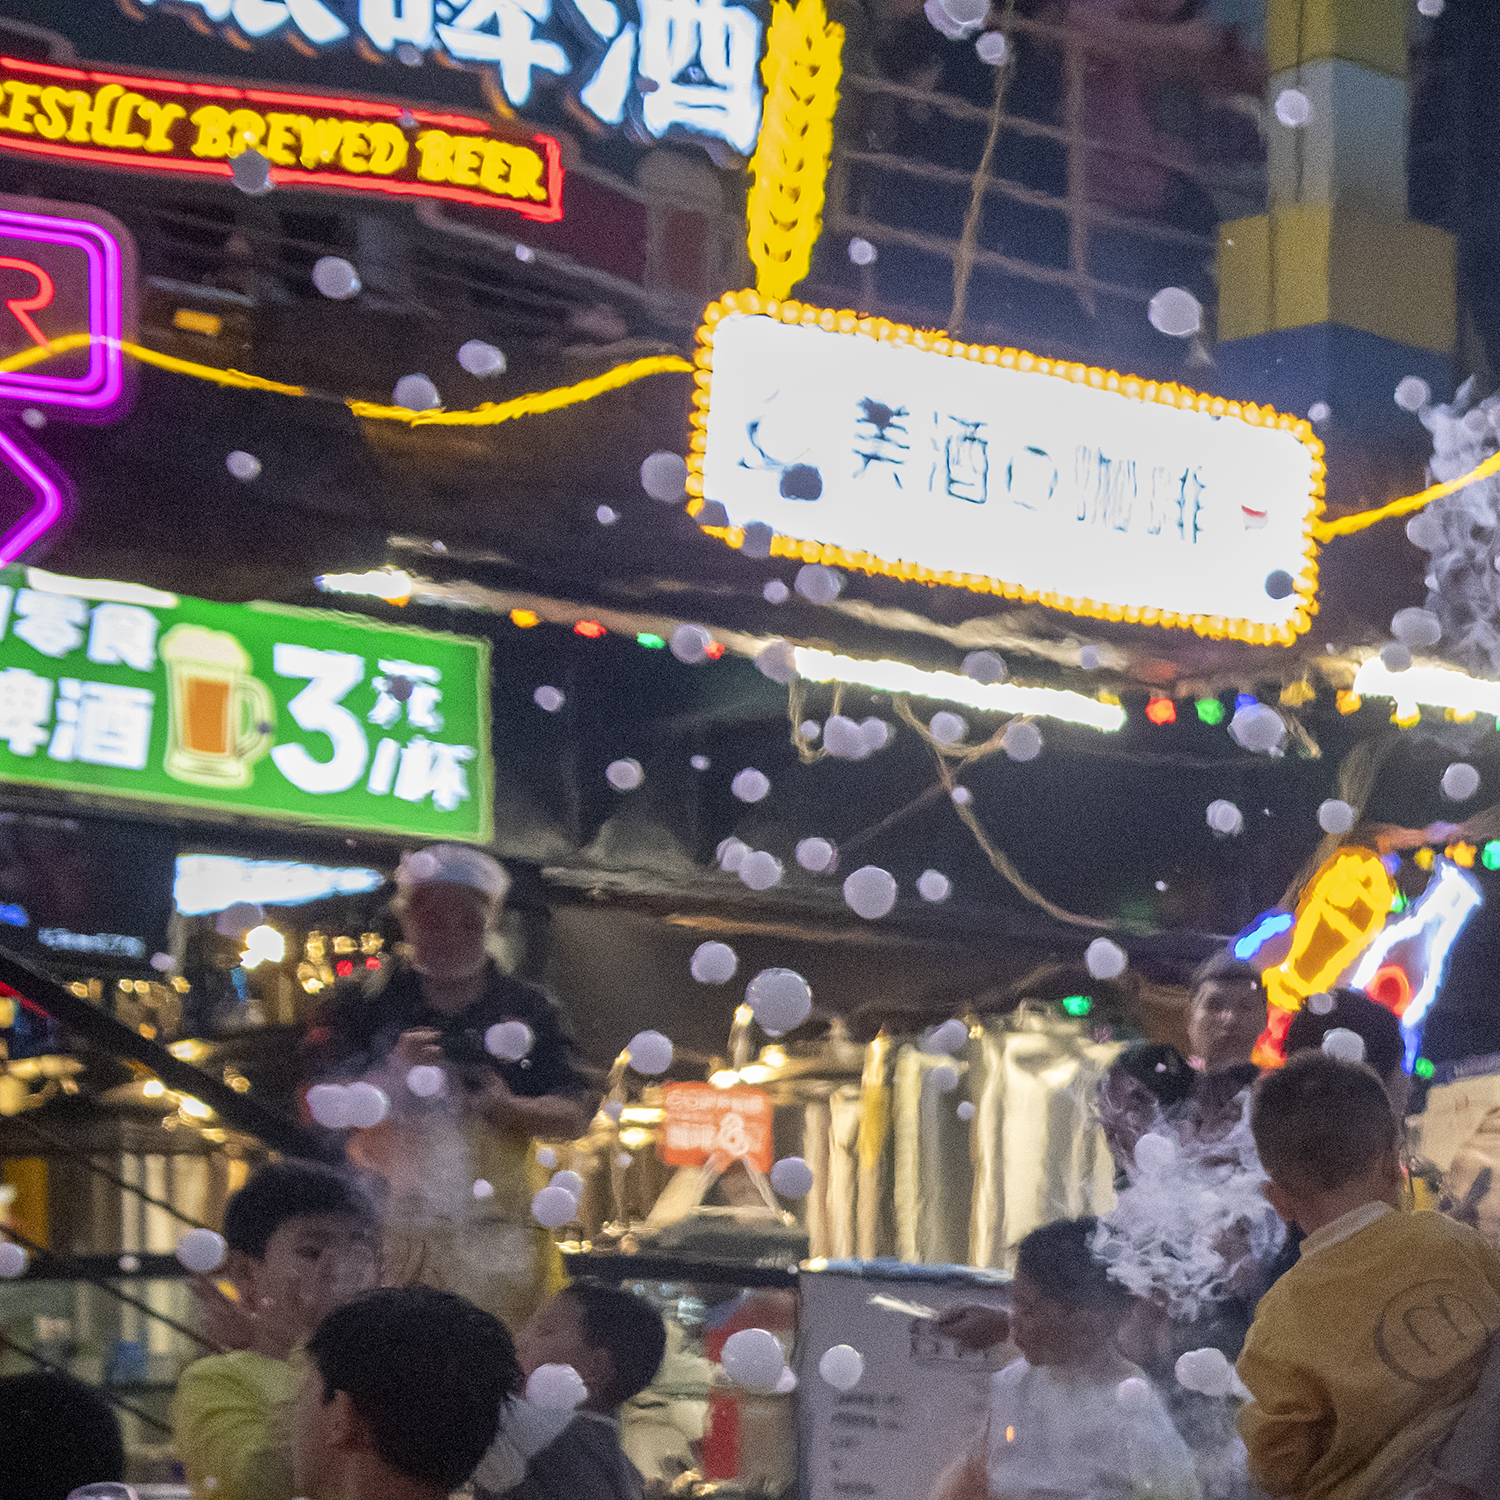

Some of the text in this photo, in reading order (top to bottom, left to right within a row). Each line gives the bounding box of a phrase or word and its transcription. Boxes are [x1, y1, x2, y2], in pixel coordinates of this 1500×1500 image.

[0, 79, 547, 200] ESHLY BREWED BEER
[0, 585, 160, 672] 零食
[271, 642, 369, 794] 3
